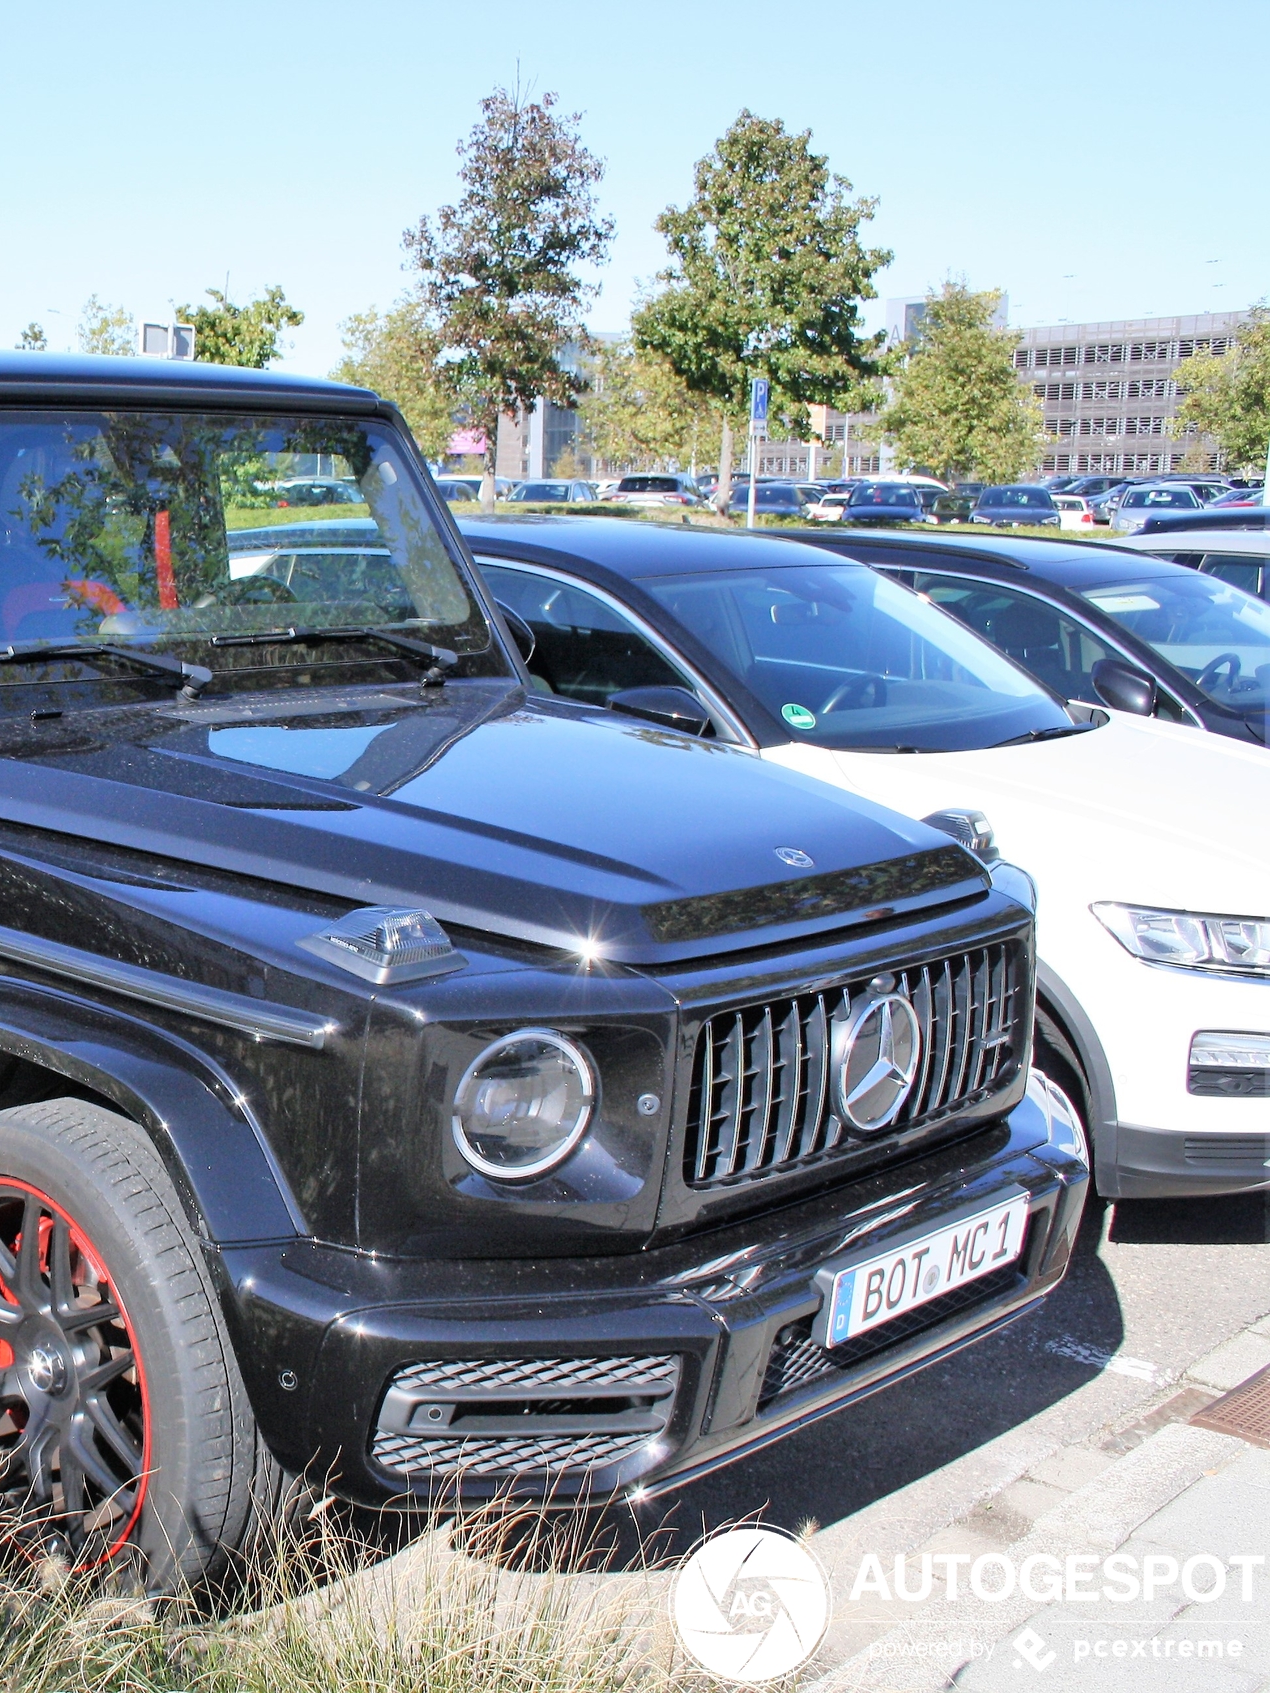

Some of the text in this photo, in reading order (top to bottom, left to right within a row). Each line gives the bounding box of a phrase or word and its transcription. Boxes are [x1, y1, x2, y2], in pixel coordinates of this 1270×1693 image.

[756, 382, 765, 403] P
[861, 1209, 1012, 1322] BOT MC 1
[836, 1313, 846, 1331] D
